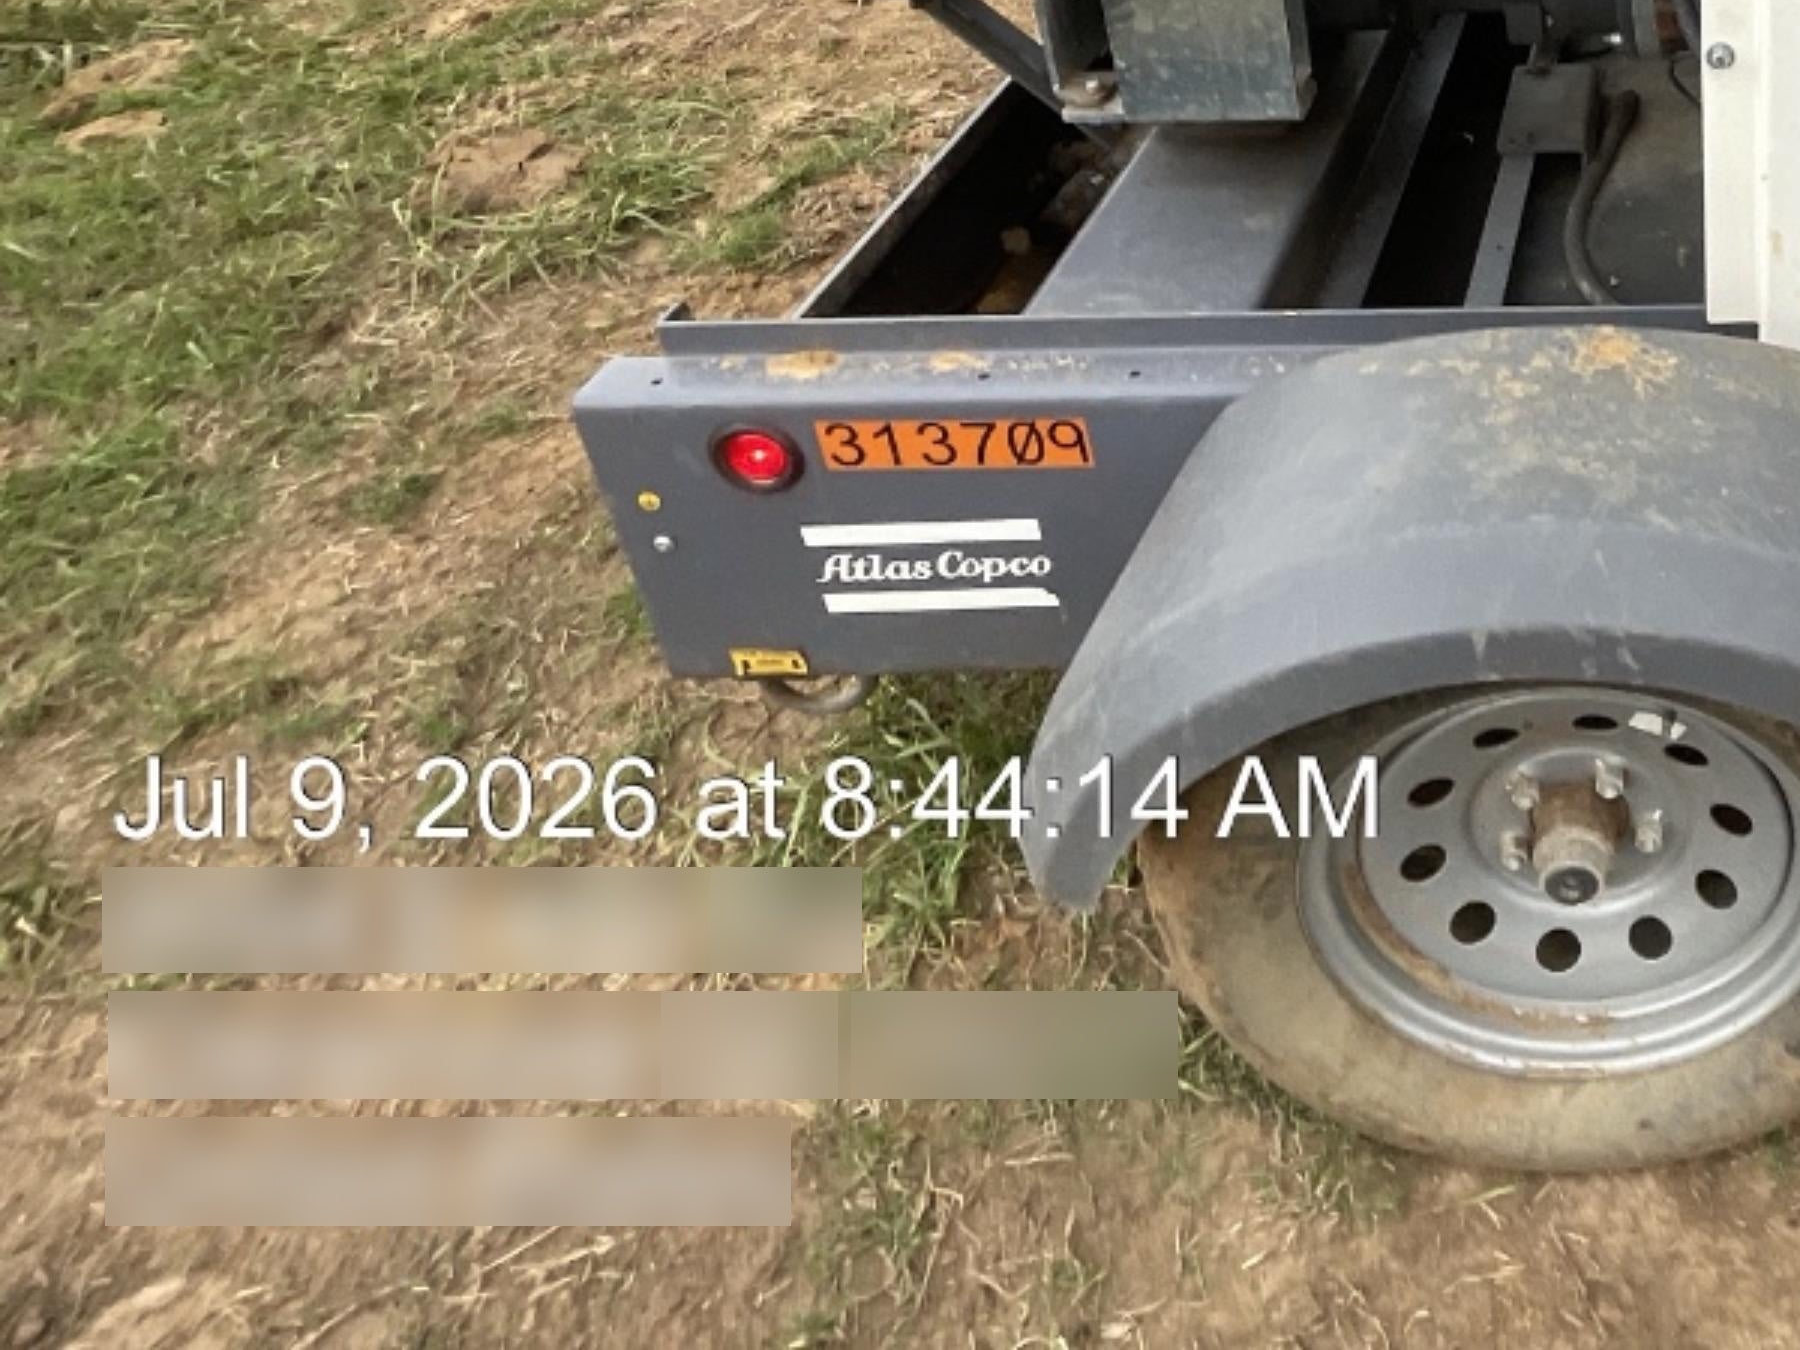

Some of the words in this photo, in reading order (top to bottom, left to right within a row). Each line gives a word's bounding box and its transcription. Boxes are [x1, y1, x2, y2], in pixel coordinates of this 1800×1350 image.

[825, 420, 1091, 467] 313709
[815, 553, 933, 583] Atlas
[936, 550, 1052, 583] Copco
